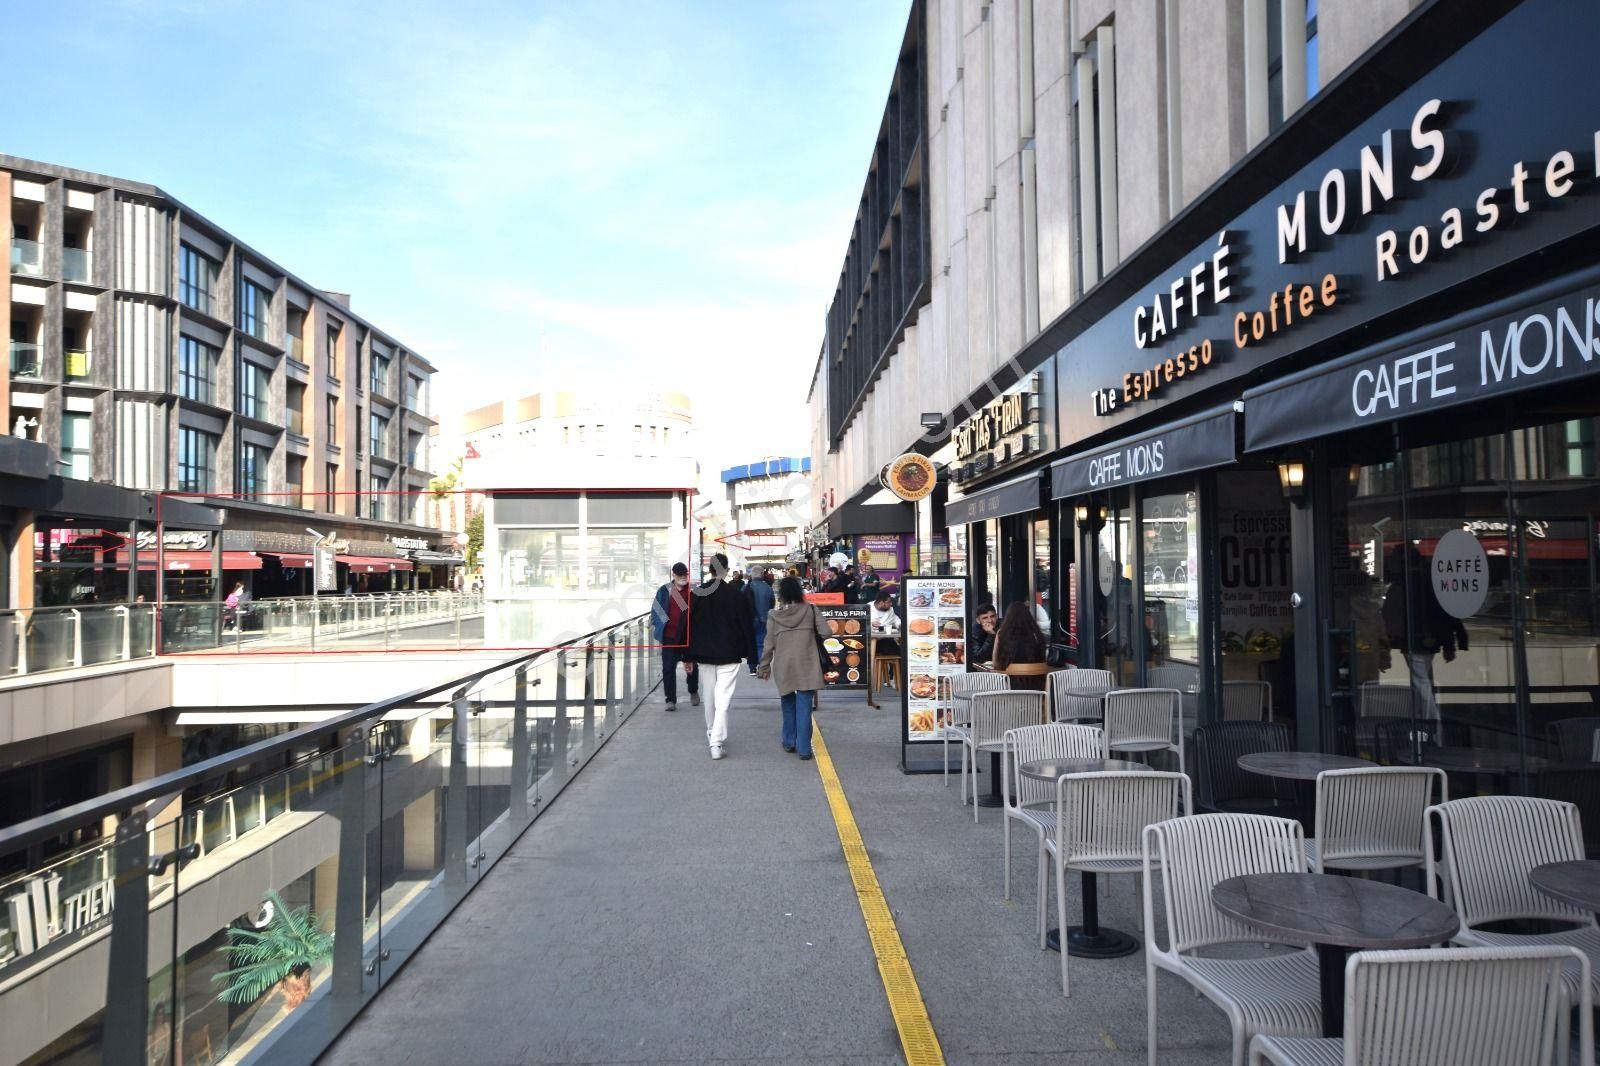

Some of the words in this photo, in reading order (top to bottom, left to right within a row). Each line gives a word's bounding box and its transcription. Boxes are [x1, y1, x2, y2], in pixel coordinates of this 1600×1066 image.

[1134, 230, 1231, 349] CAFFÉ
[1277, 98, 1445, 265] MONS
[1091, 387, 1116, 417] The
[1122, 338, 1212, 403] Espresso
[1233, 273, 1338, 349] Coffee
[1352, 341, 1457, 417] CAFFE
[1480, 297, 1600, 386] MON
[1088, 452, 1122, 487] CAFFE
[1126, 440, 1164, 479] MONS
[1436, 554, 1482, 574] CAFFÉ
[1440, 578, 1480, 593] MONS
